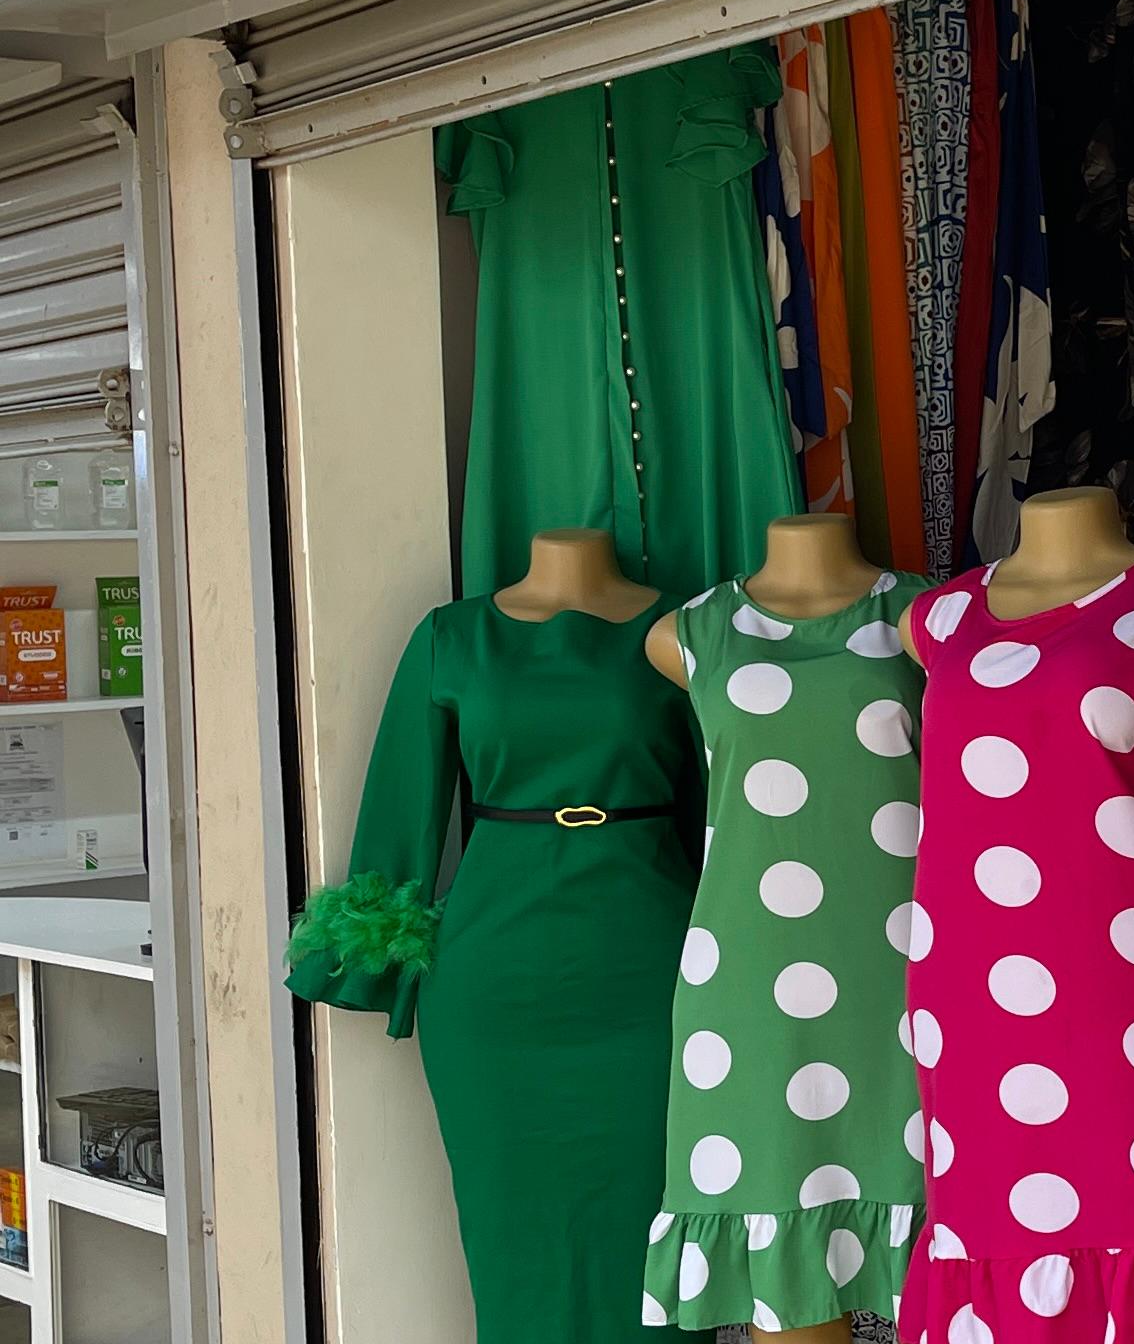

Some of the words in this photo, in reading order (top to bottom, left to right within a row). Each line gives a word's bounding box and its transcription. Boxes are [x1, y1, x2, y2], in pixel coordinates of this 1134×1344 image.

[102, 587, 139, 600] TRUS
[3, 596, 48, 607] TRUST
[11, 629, 62, 645] TRUST
[114, 626, 142, 641] TRU
